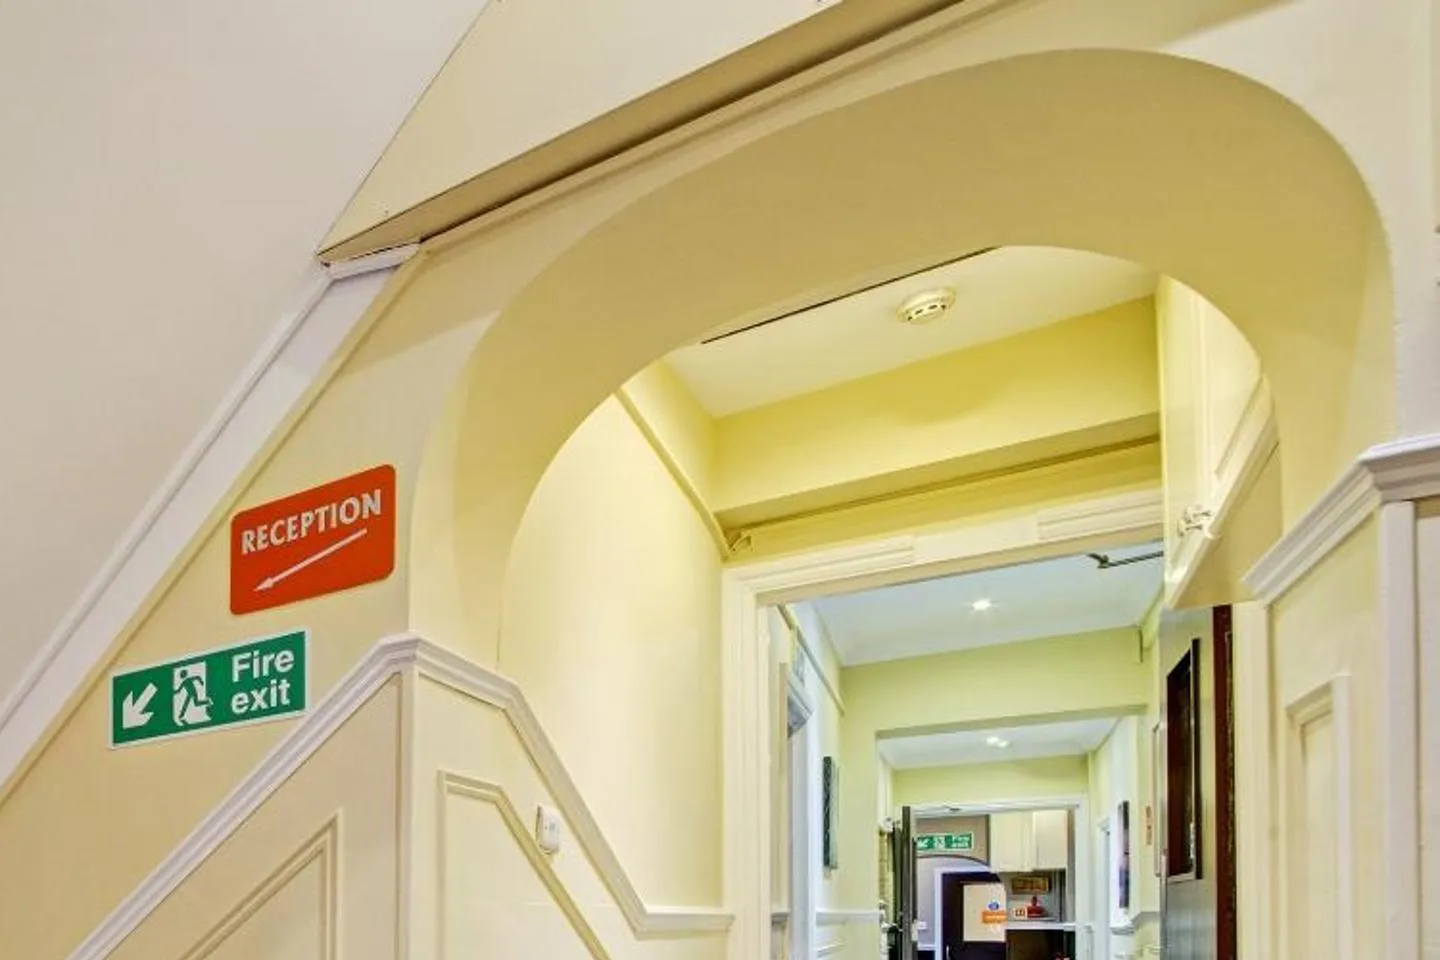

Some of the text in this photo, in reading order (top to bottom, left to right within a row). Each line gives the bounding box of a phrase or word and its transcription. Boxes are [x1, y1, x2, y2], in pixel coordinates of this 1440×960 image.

[242, 490, 381, 554] RECEPTION
[232, 649, 294, 681] Fire
[231, 679, 291, 713] exit
